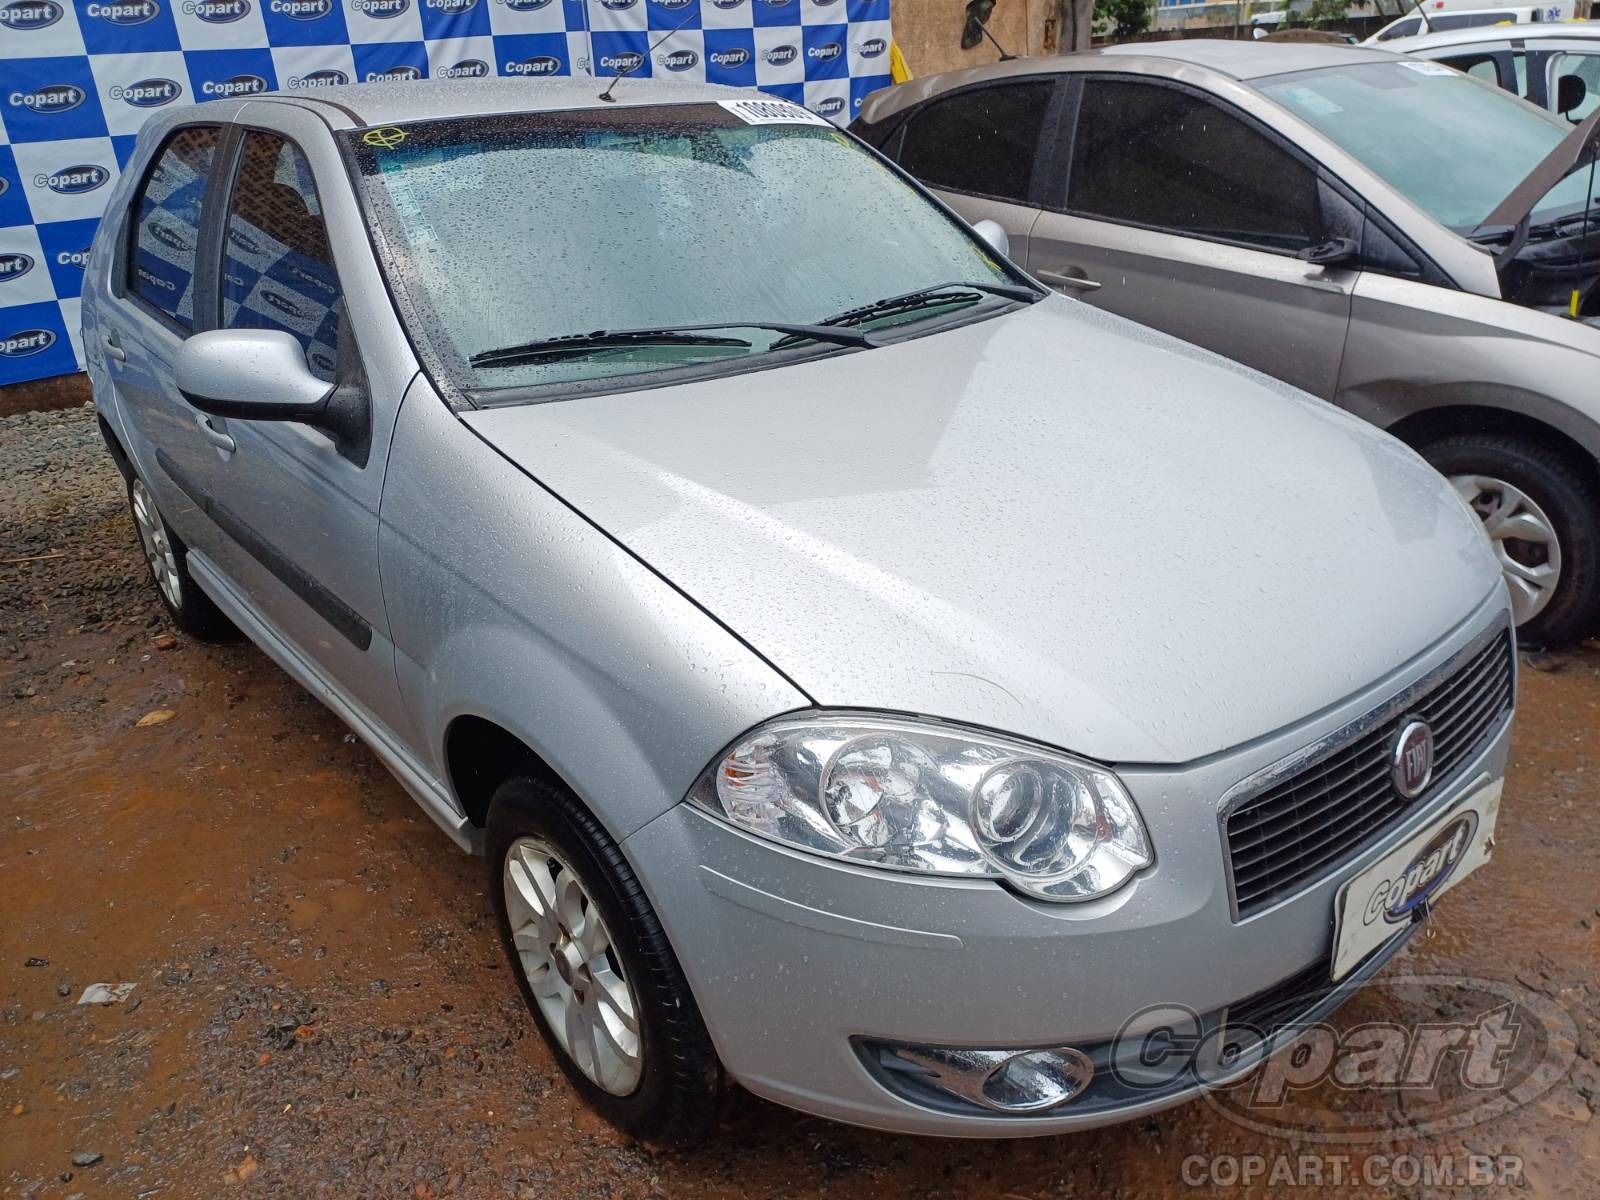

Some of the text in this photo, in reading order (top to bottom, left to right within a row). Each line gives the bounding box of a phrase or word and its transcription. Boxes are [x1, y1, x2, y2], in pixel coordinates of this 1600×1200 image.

[87, 3, 150, 19] Copart
[182, 1, 240, 17] Copart
[271, 0, 324, 15] Copart
[351, 0, 401, 12] Copart
[657, 54, 692, 66] Copart
[710, 52, 745, 65] Copart
[761, 49, 792, 62] Copart
[808, 47, 838, 58] Copart
[505, 59, 553, 73] Copart
[600, 56, 638, 69] Copart
[366, 70, 414, 83] Copart
[437, 63, 482, 79] Copart
[203, 79, 260, 95] Copart
[287, 75, 340, 90] Copart
[9, 89, 76, 108] Copart
[110, 84, 171, 101] Copart
[34, 168, 98, 189] Copart
[1406, 739, 1427, 781] FIAT
[1362, 819, 1467, 927] Copart
